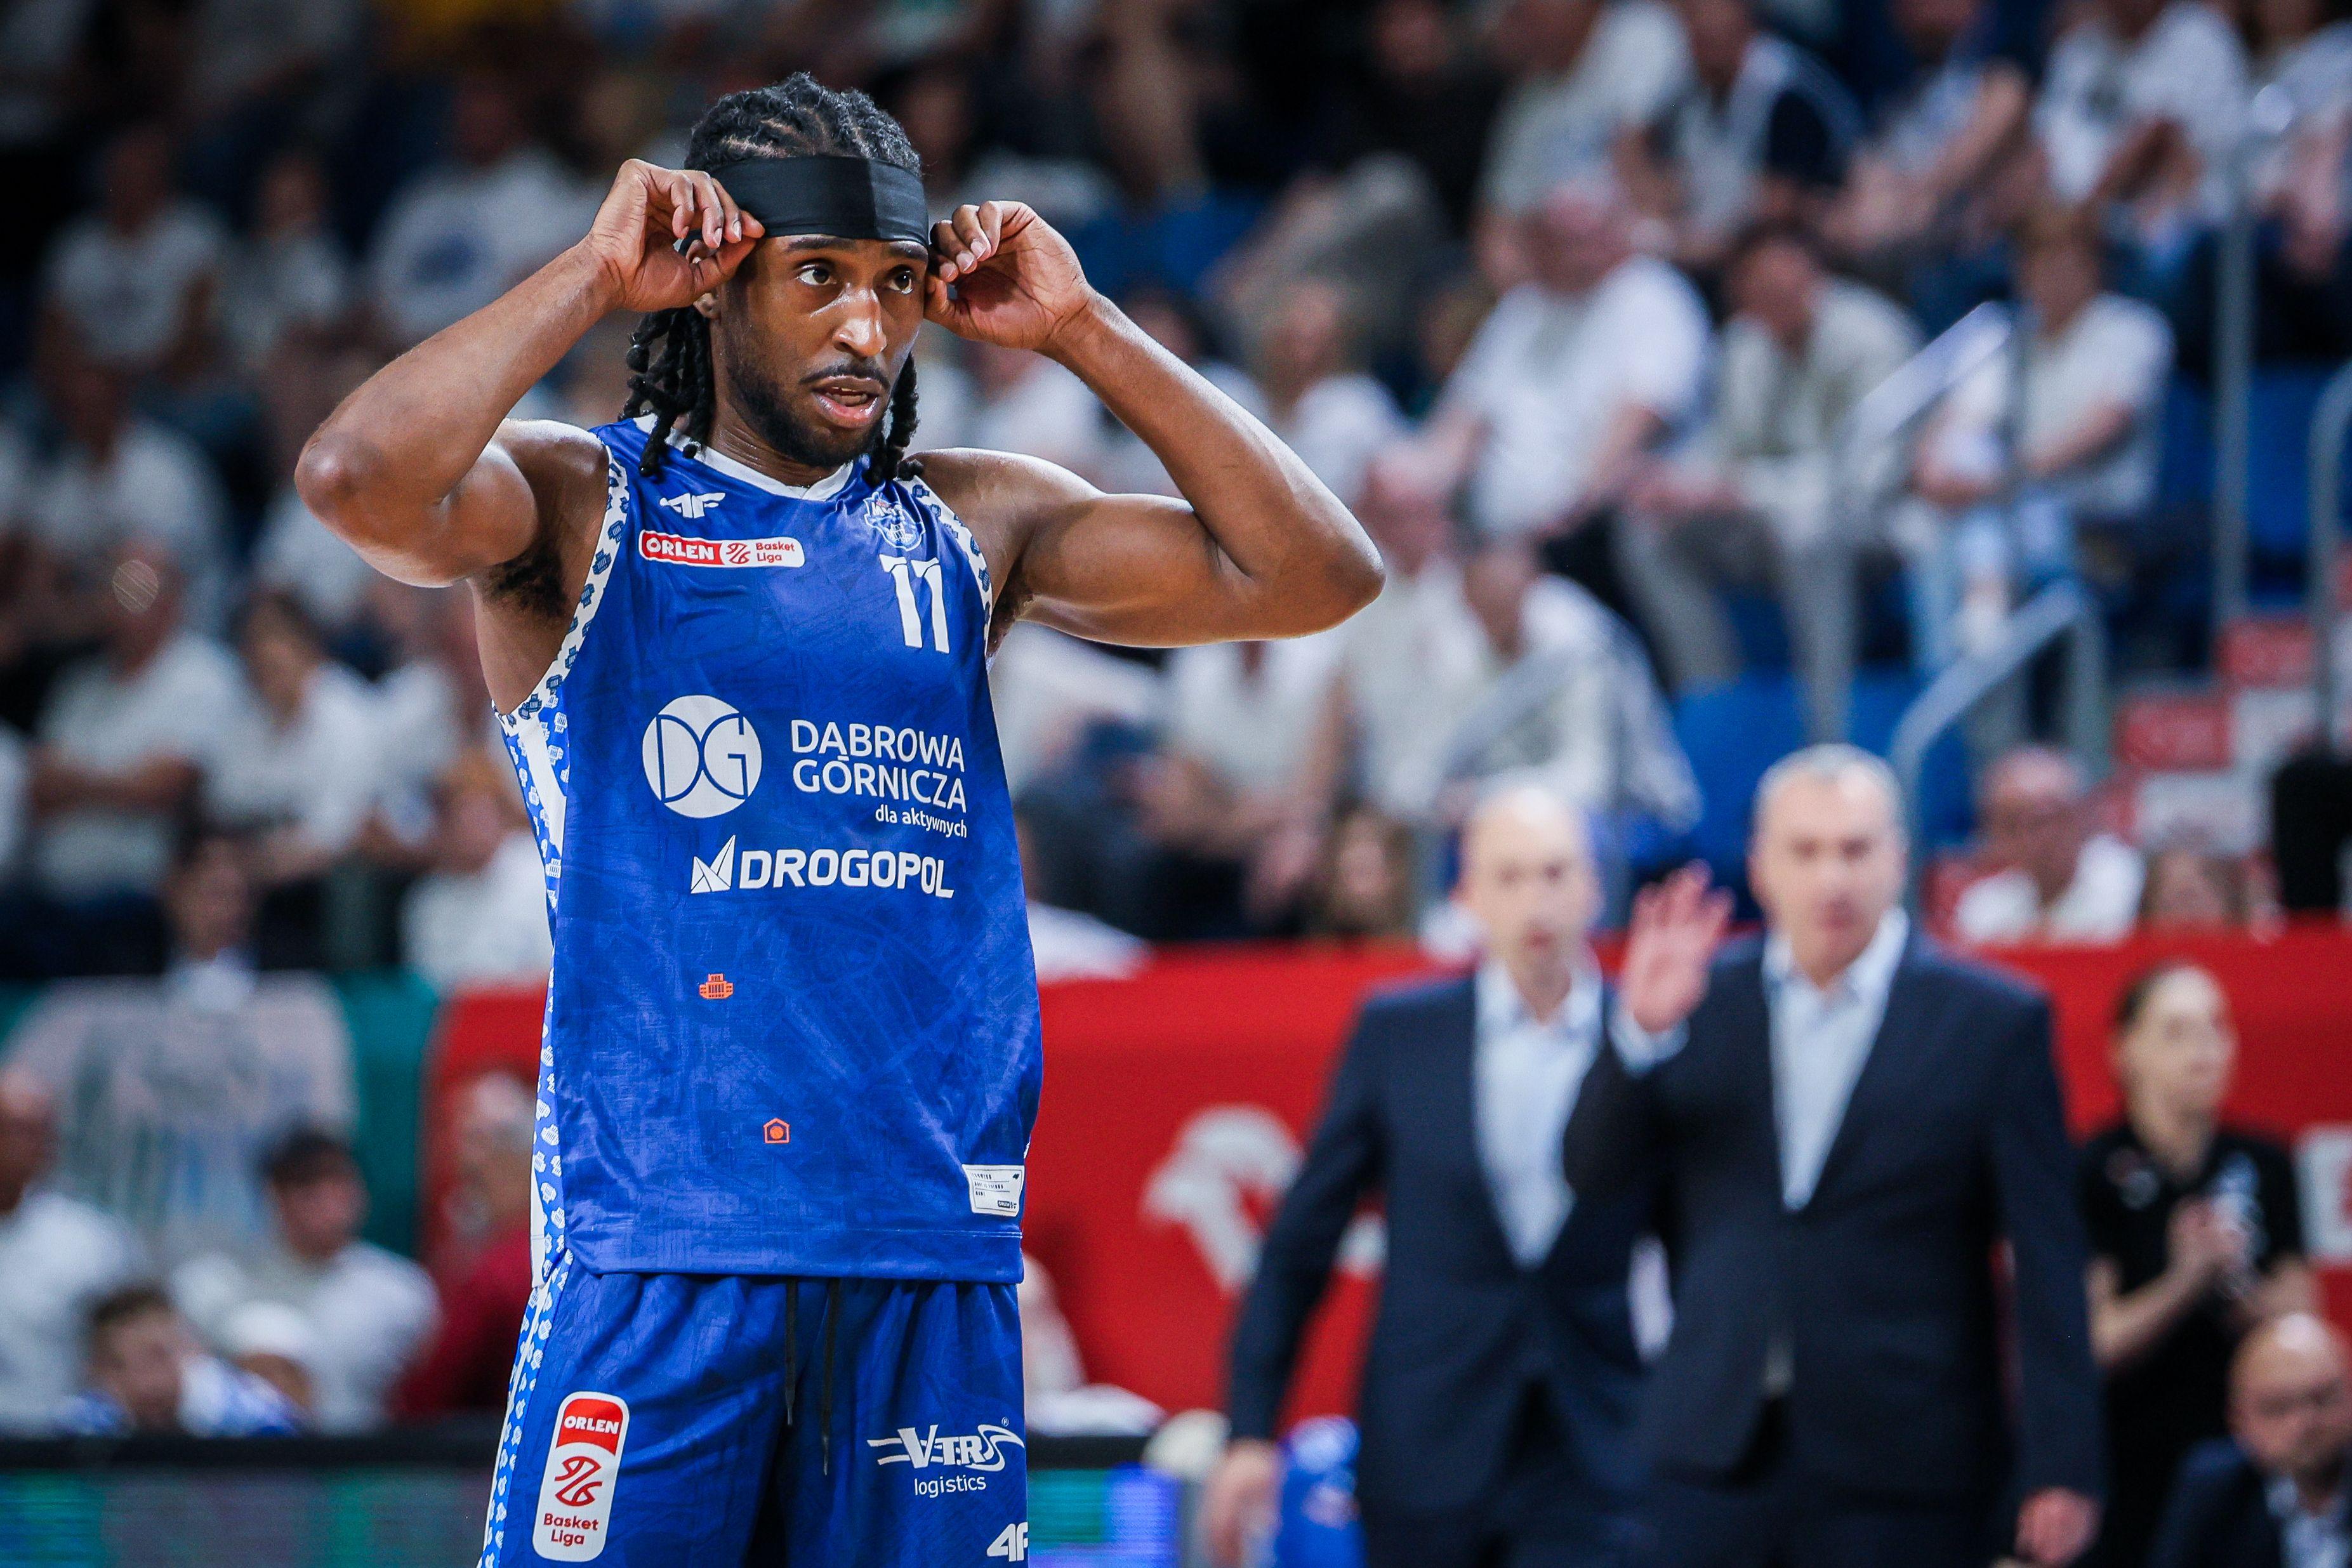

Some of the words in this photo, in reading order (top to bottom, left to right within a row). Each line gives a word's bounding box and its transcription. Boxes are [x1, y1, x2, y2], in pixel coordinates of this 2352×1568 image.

[646, 537, 715, 560] ORLEN
[755, 541, 795, 551] Basket
[756, 551, 783, 563] Liga
[879, 554, 949, 654] 11
[875, 804, 898, 824] dla
[902, 807, 967, 838] aktywnych
[739, 849, 955, 899] DROGOPOL
[564, 1415, 620, 1435] ORLEN
[914, 1475, 986, 1498] logistics
[543, 1513, 598, 1531] Basket
[551, 1529, 585, 1546] Liga
